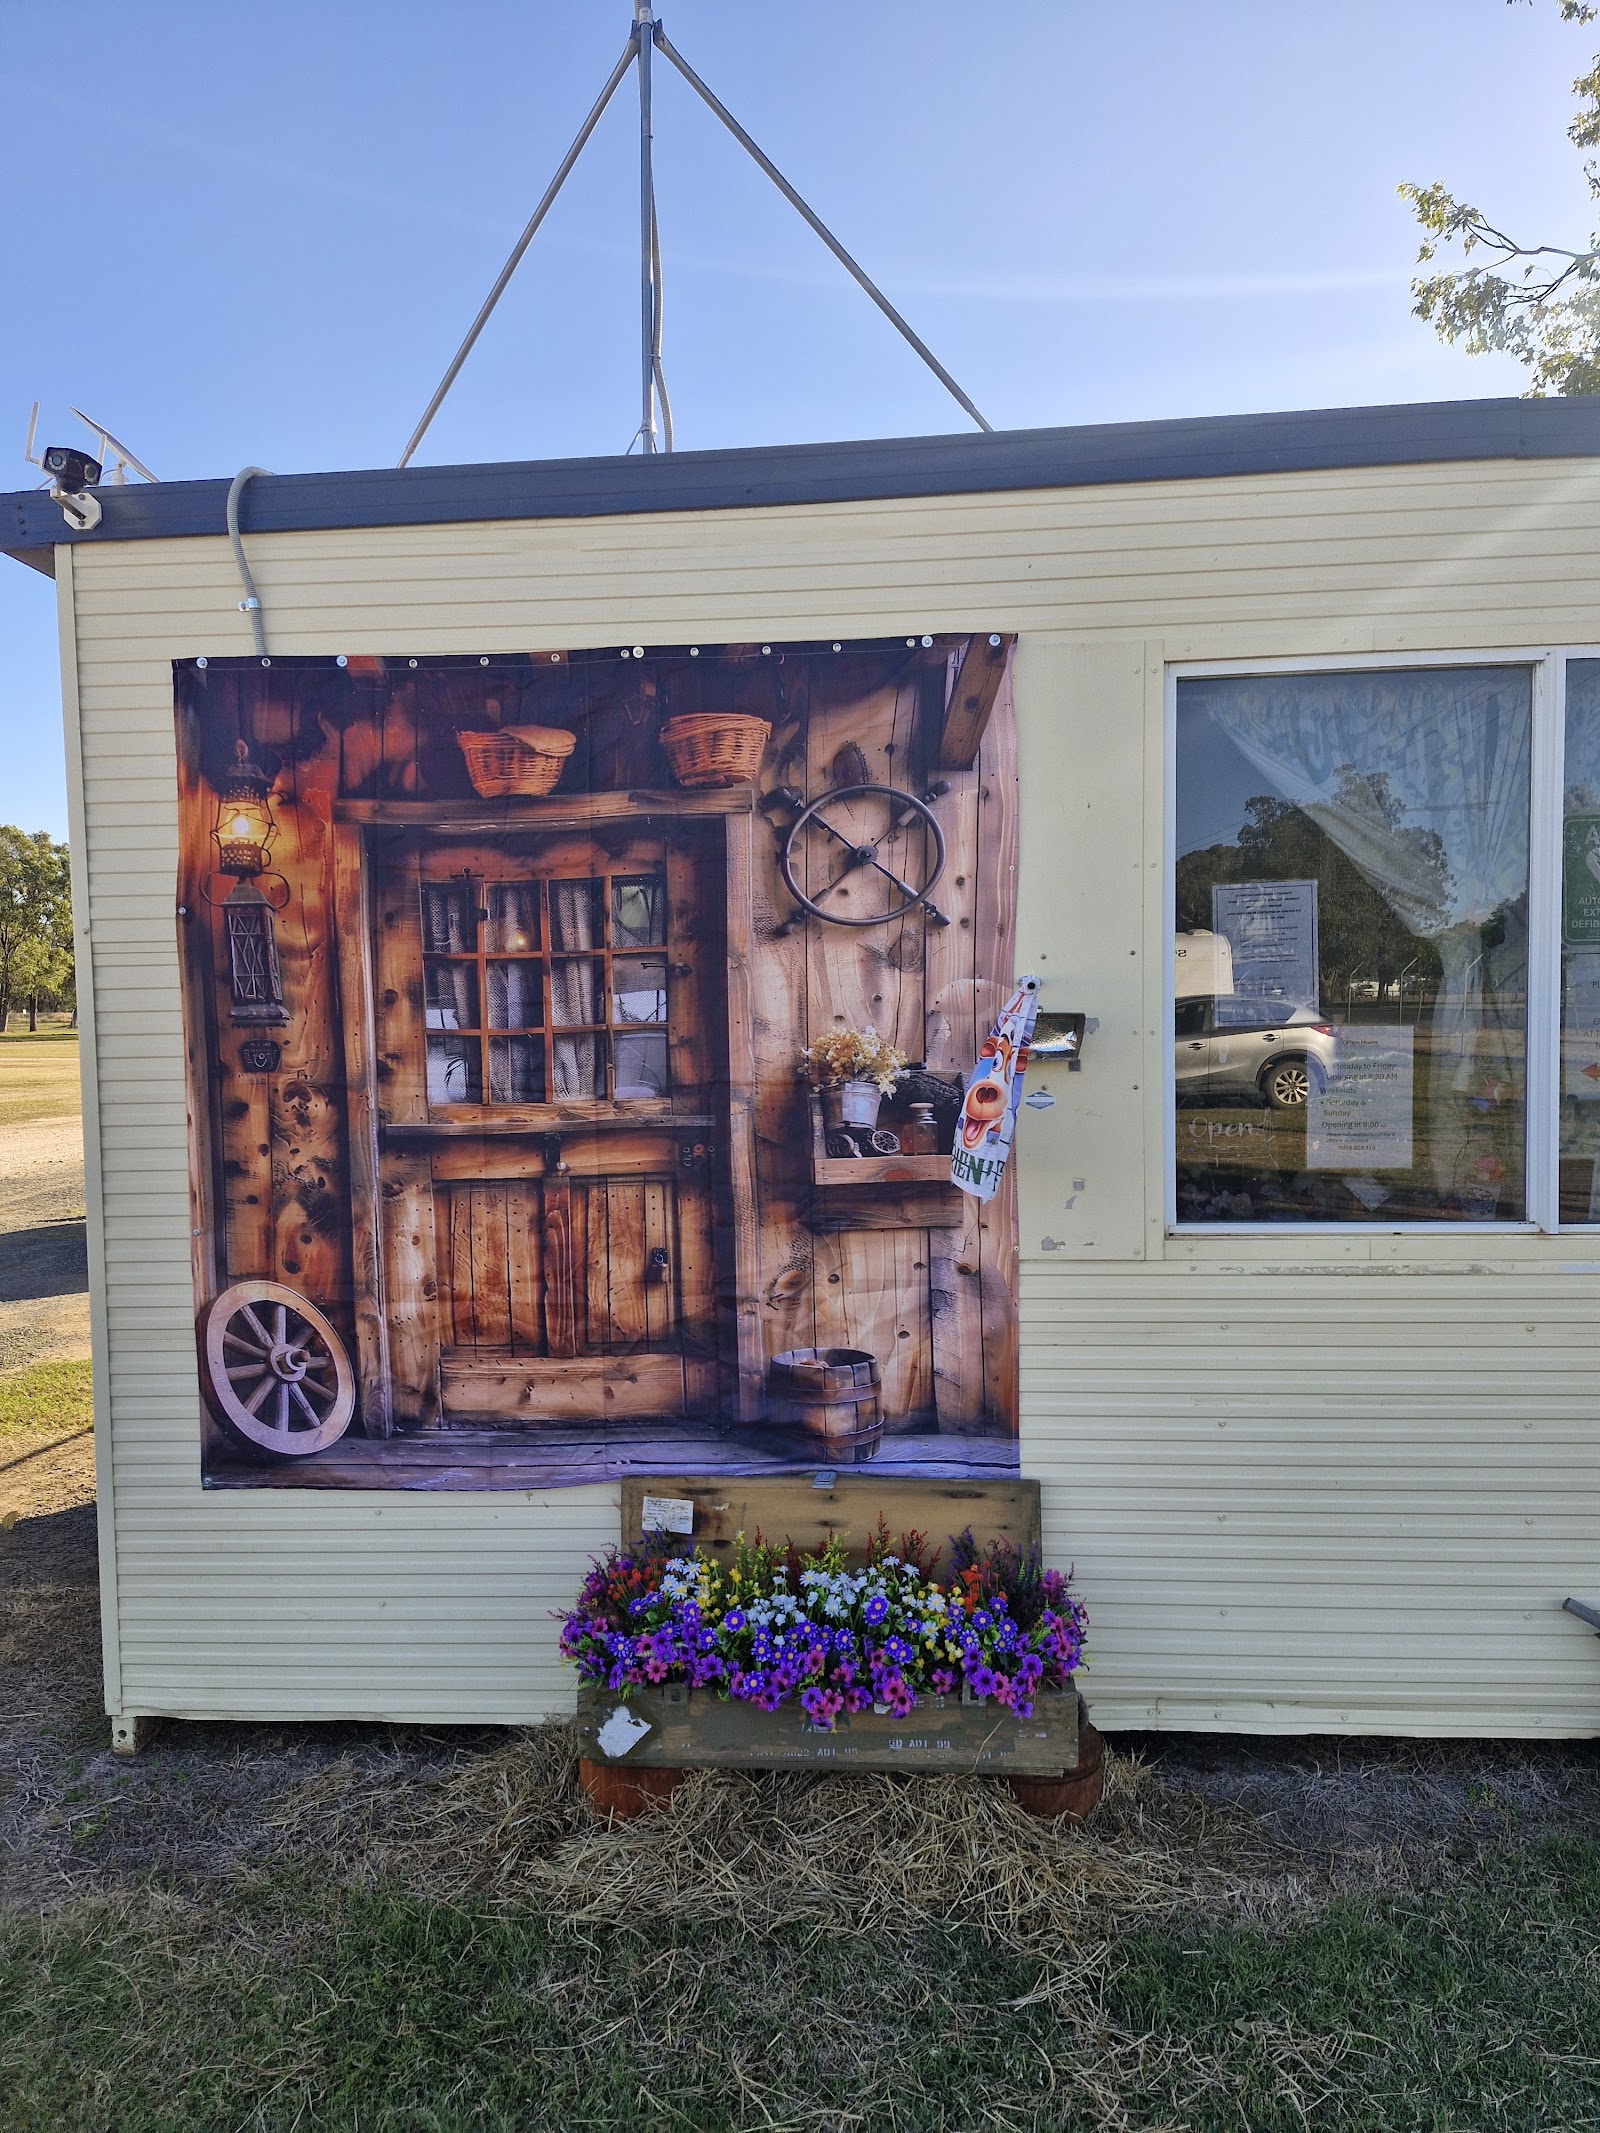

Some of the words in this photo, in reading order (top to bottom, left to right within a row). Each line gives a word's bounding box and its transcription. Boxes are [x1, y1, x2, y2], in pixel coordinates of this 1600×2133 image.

[1332, 1062, 1362, 1070] Monday
[1363, 1062, 1372, 1070] to
[1326, 1073, 1358, 1081] Opening
[1326, 1099, 1360, 1107] Saturday
[1323, 1109, 1351, 1117] Sunday
[1321, 1121, 1353, 1130] Opening
[1188, 1116, 1254, 1144] Open
